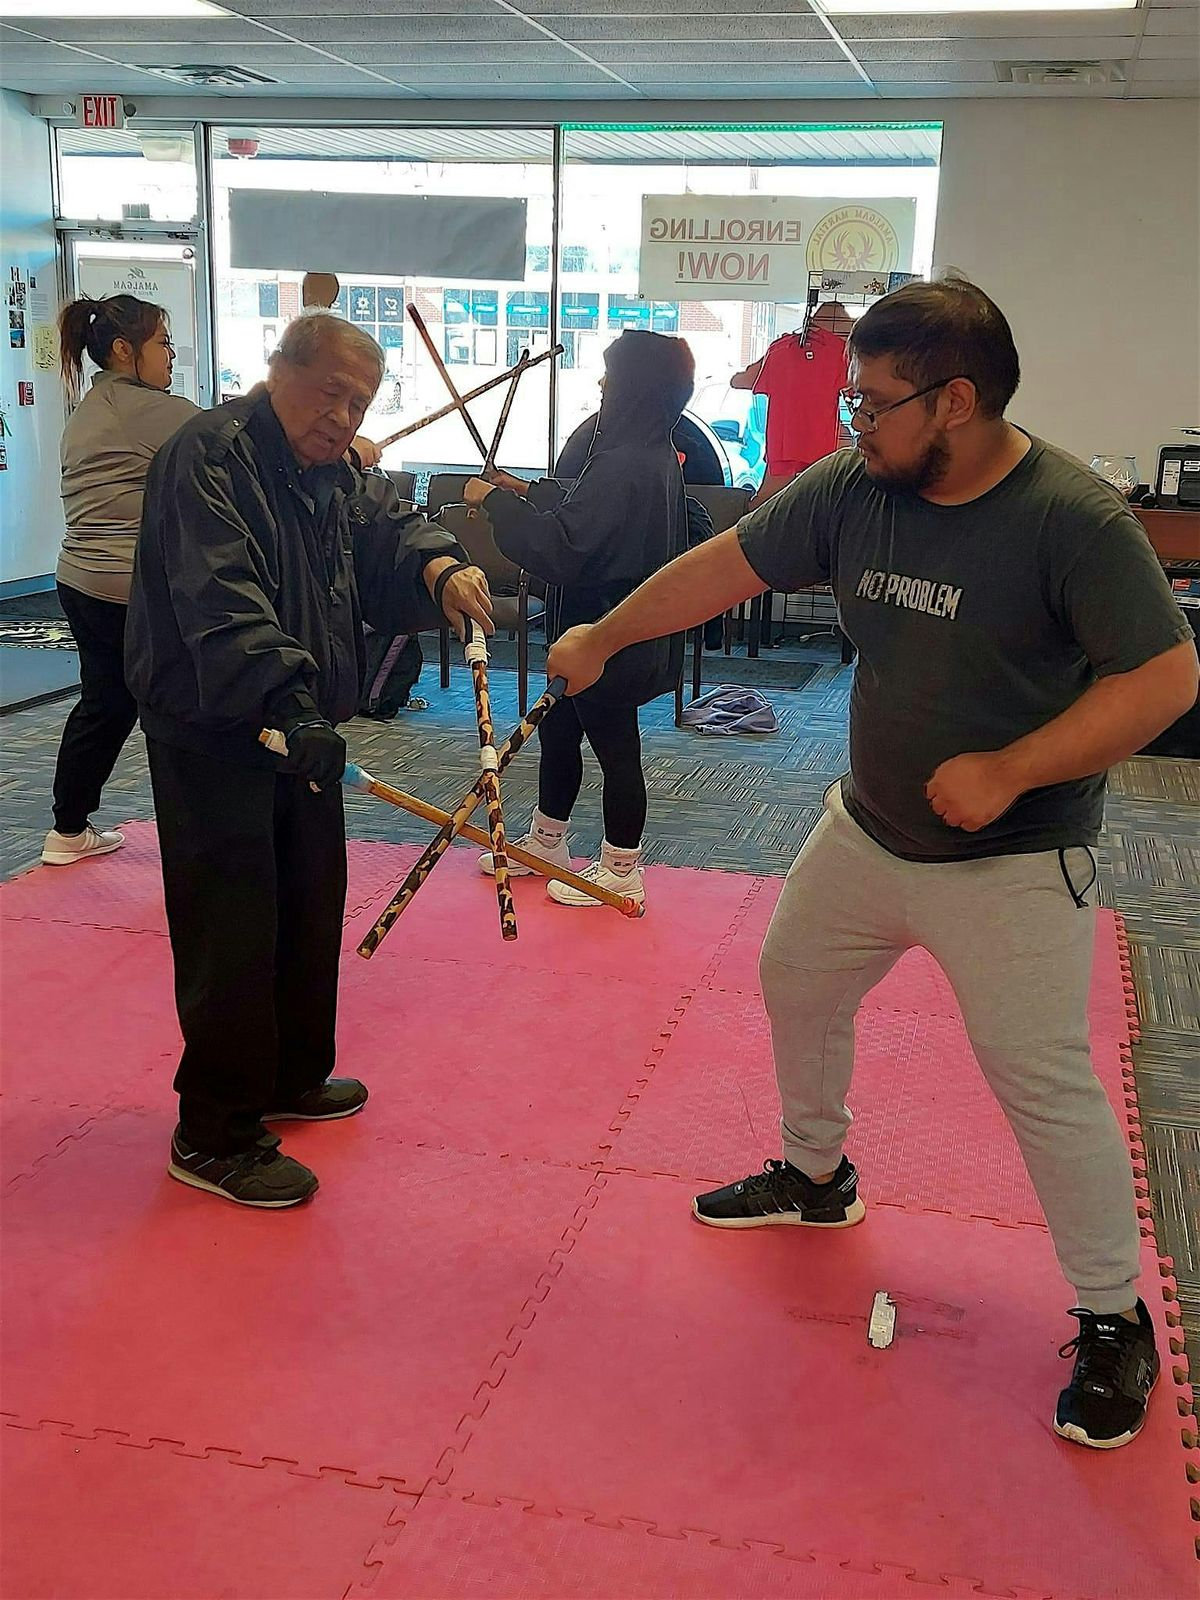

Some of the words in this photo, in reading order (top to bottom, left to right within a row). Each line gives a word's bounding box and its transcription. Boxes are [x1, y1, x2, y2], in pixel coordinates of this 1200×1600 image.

[83, 96, 117, 127] EXIT
[855, 569, 885, 600] NO
[884, 573, 963, 620] PROBLEM
